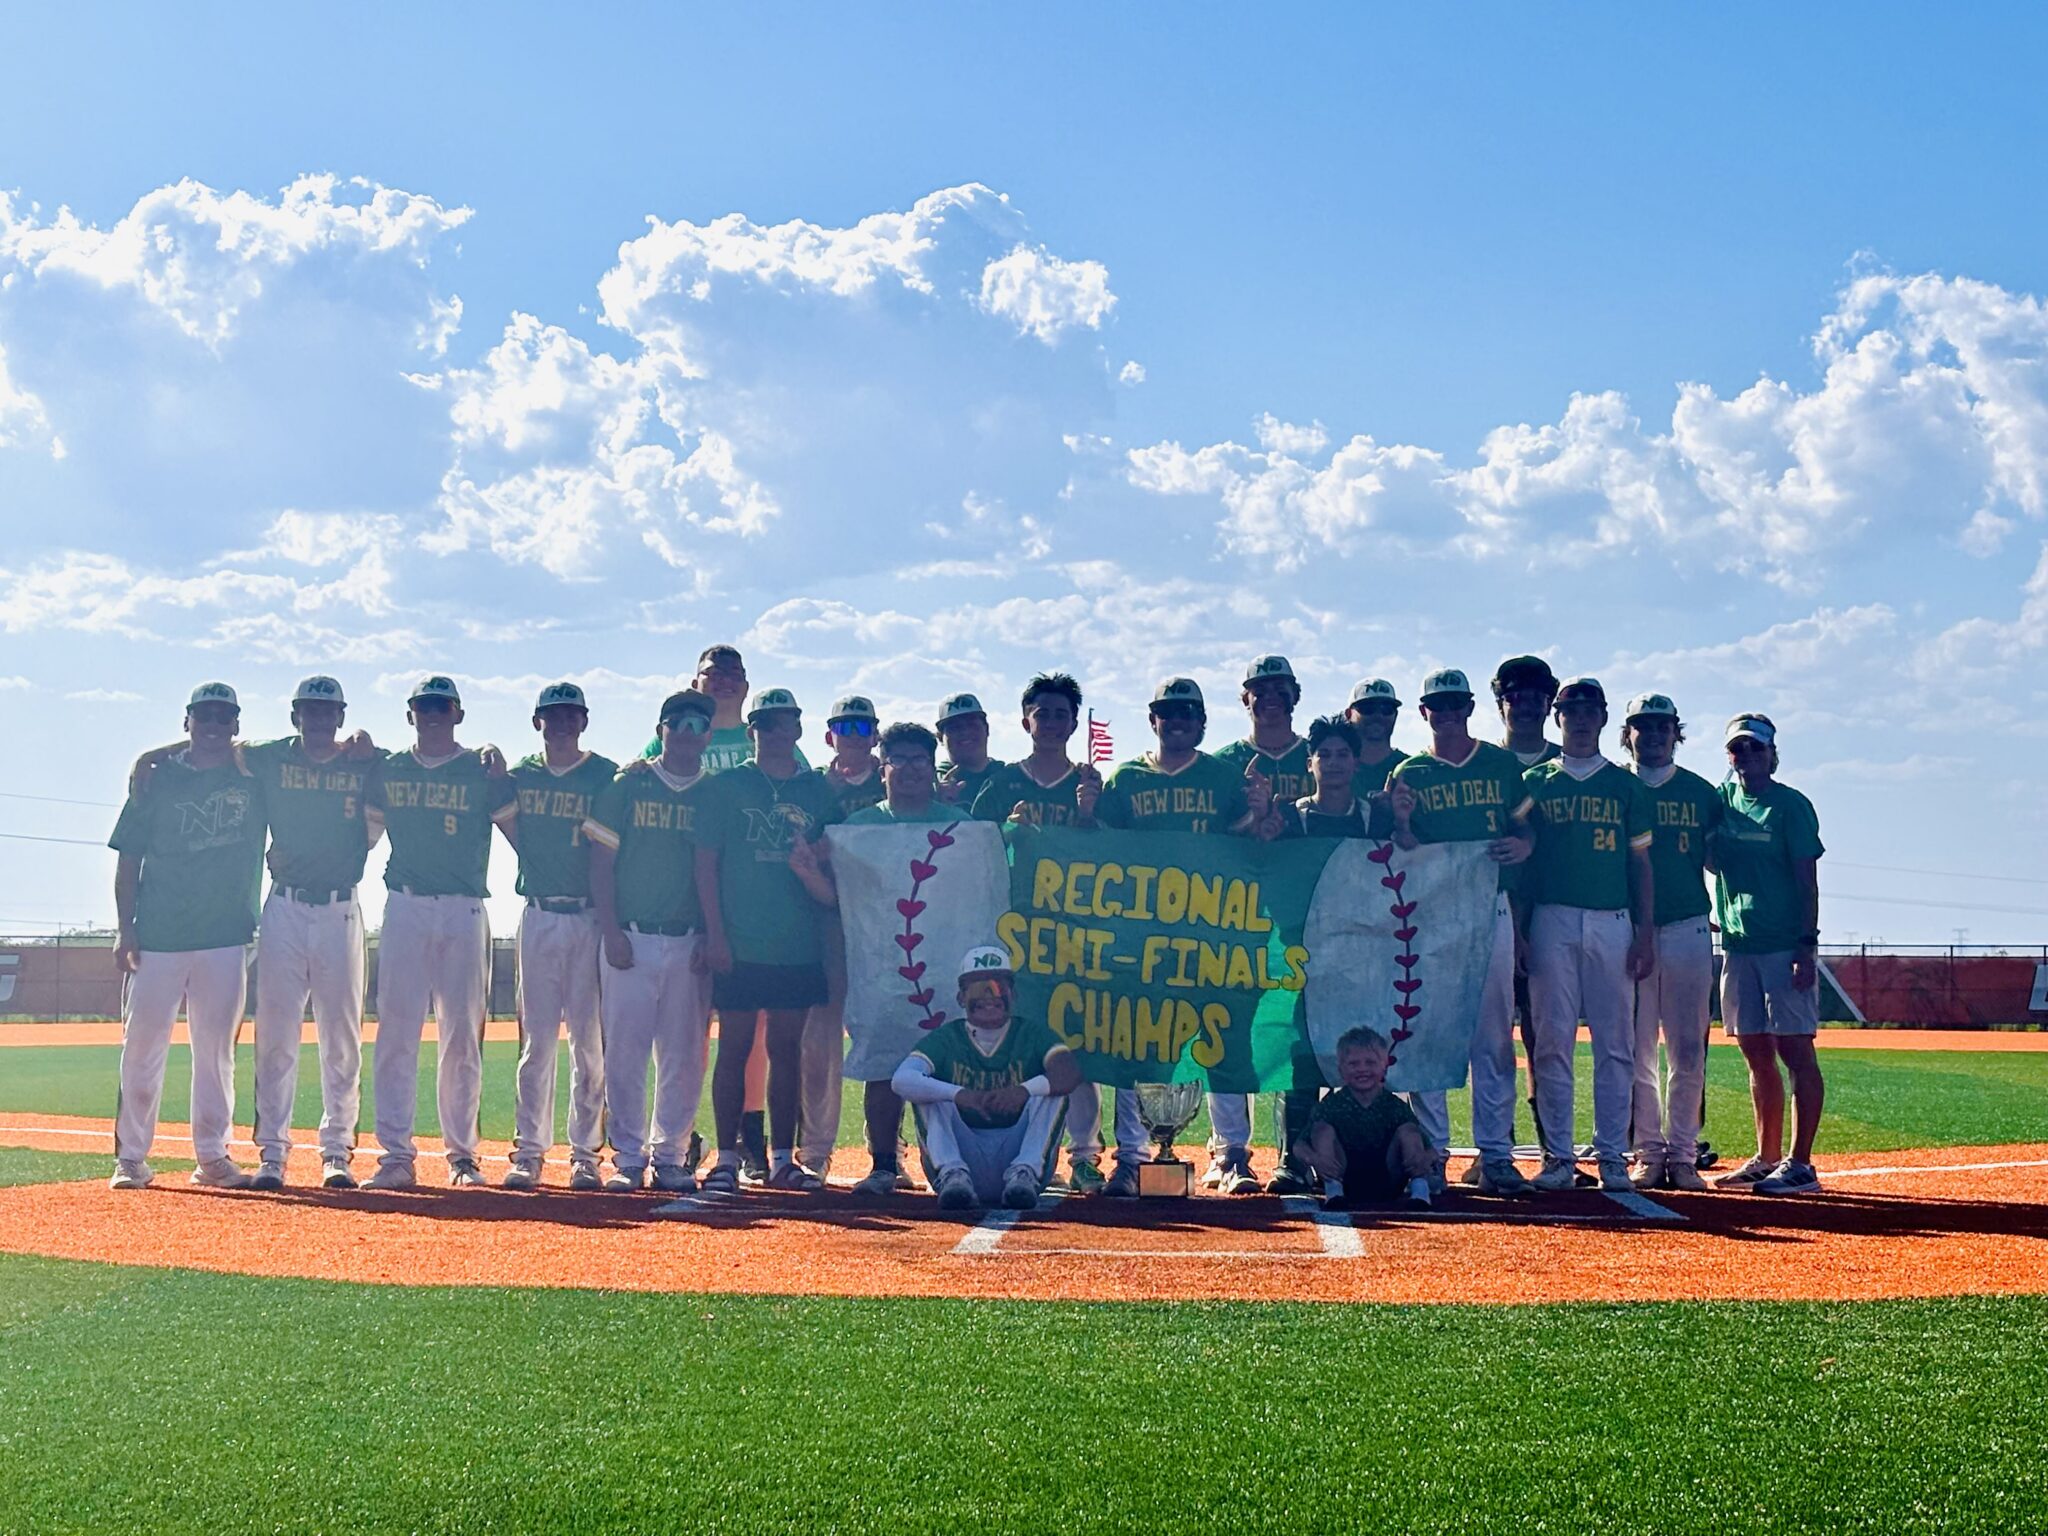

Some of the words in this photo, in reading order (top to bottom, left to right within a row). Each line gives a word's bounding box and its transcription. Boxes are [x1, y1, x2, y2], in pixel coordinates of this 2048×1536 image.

[280, 763, 320, 789] NEW
[384, 782, 422, 807] NEW
[425, 783, 470, 811] DEAL
[1131, 789, 1170, 817] NEW
[1173, 788, 1217, 815] DEAL
[1418, 783, 1460, 813] NEW
[1461, 779, 1504, 805] DEAL
[1539, 794, 1577, 825] NEW
[1580, 795, 1622, 825] DEAL
[633, 800, 673, 829] NEW
[1486, 811, 1497, 832] 3
[1656, 800, 1700, 827] DEAL
[1593, 827, 1616, 852] 24
[1032, 858, 1272, 932] REGIONAL
[996, 912, 1310, 991] SEMI-FINALS
[1048, 982, 1231, 1068] CHAMPS
